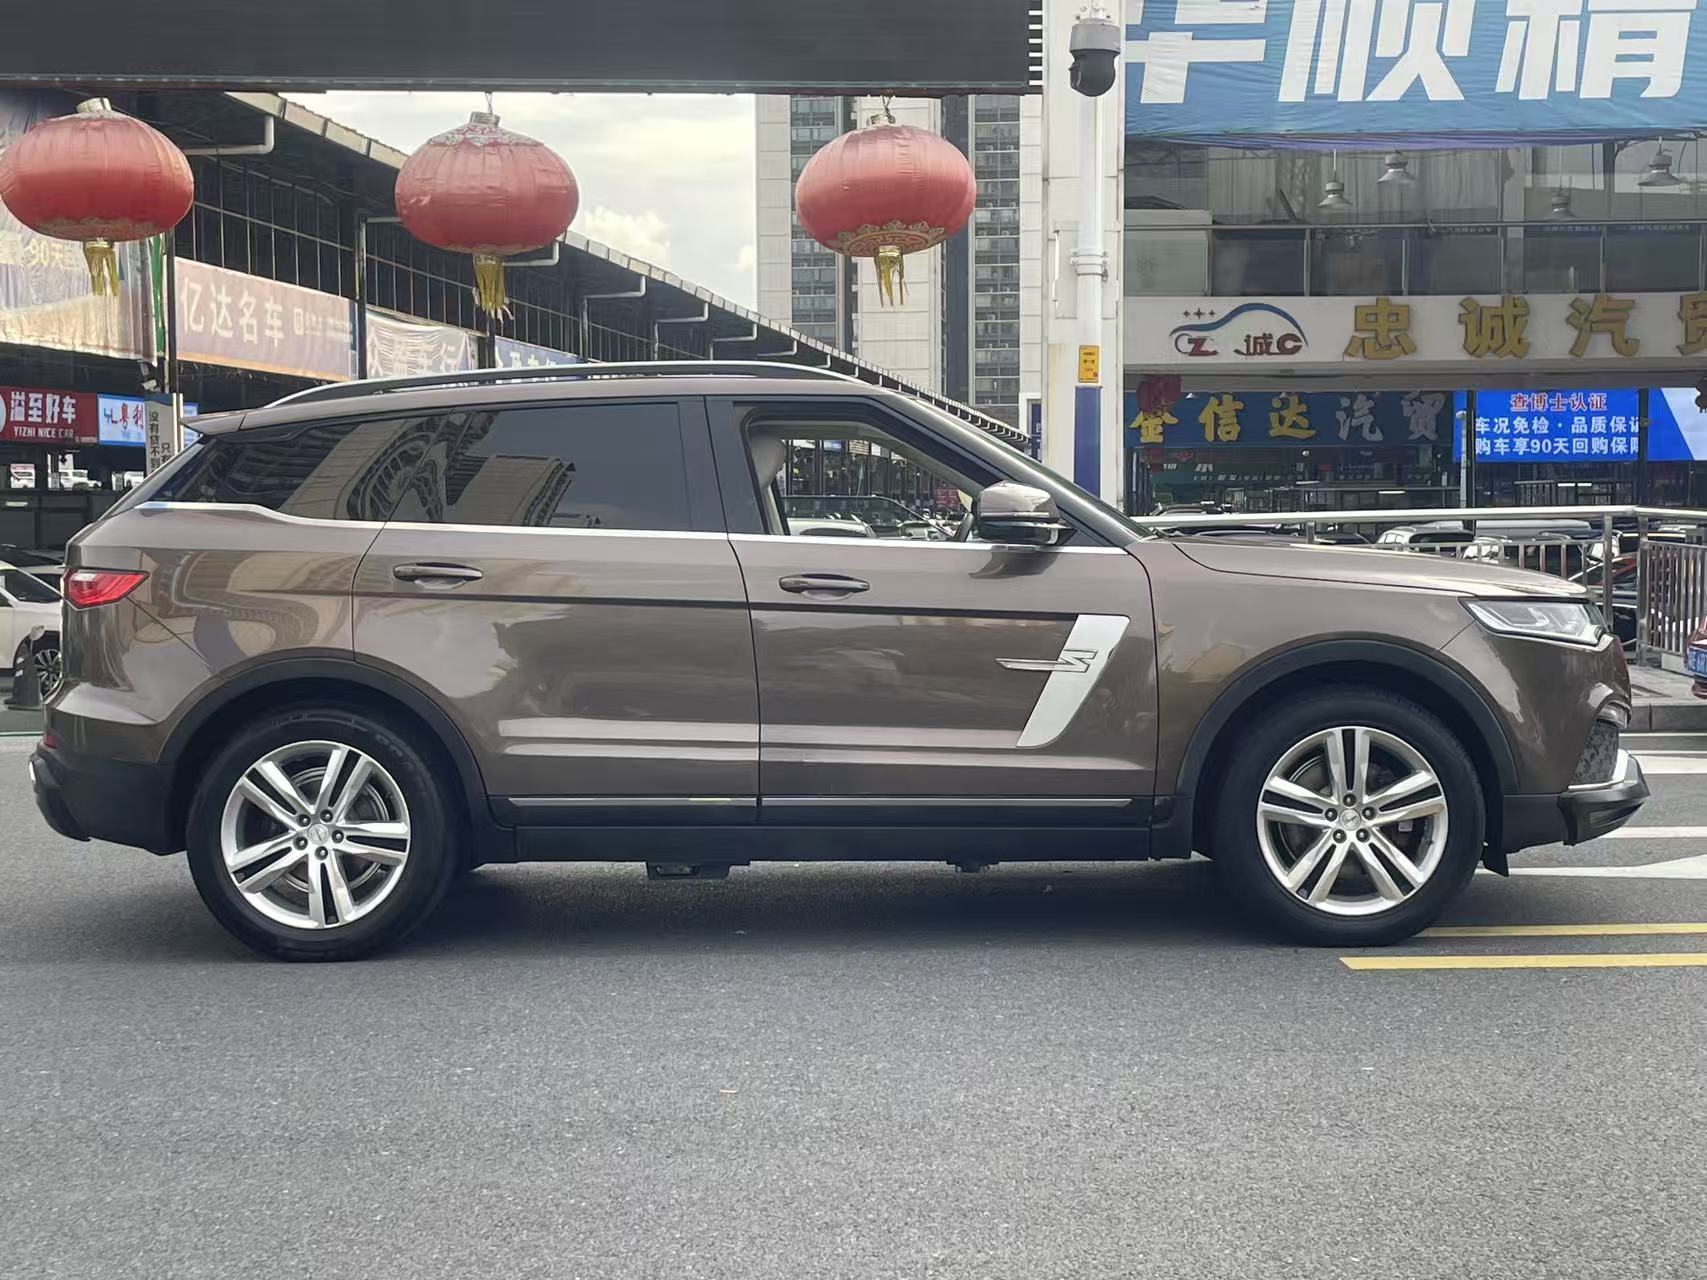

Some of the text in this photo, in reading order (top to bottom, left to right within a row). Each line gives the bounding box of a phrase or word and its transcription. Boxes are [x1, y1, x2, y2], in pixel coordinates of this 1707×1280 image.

[181, 277, 285, 348] 亿达名车
[10, 391, 77, 424] 溢至好车
[1510, 393, 1607, 412] 查博士认证
[14, 426, 74, 439] YIZHI NICE CAR
[150, 411, 161, 475] 没有贷不到
